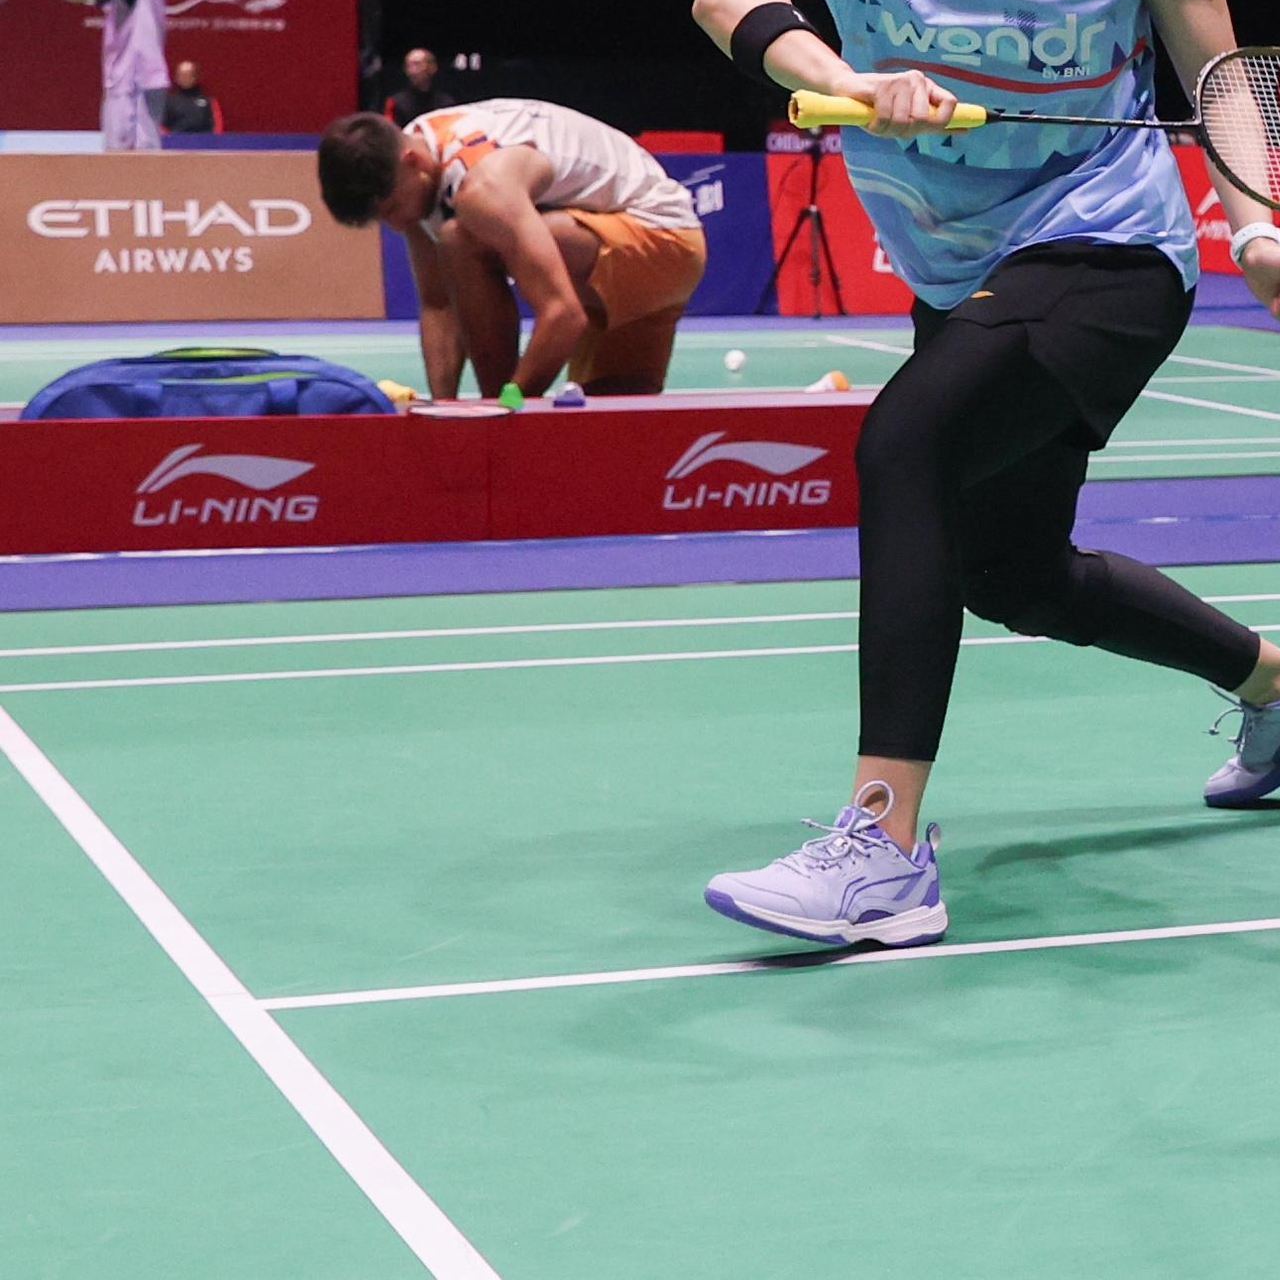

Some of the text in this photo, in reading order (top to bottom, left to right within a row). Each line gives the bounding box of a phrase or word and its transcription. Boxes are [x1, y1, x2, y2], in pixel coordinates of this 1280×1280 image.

[881, 10, 1107, 66] wondr
[1043, 66, 1090, 80] by BNI
[27, 199, 312, 238] ETIHAD
[94, 247, 254, 274] AIRWAYS
[663, 479, 832, 510] LI-NING
[133, 495, 320, 527] LI-NING
